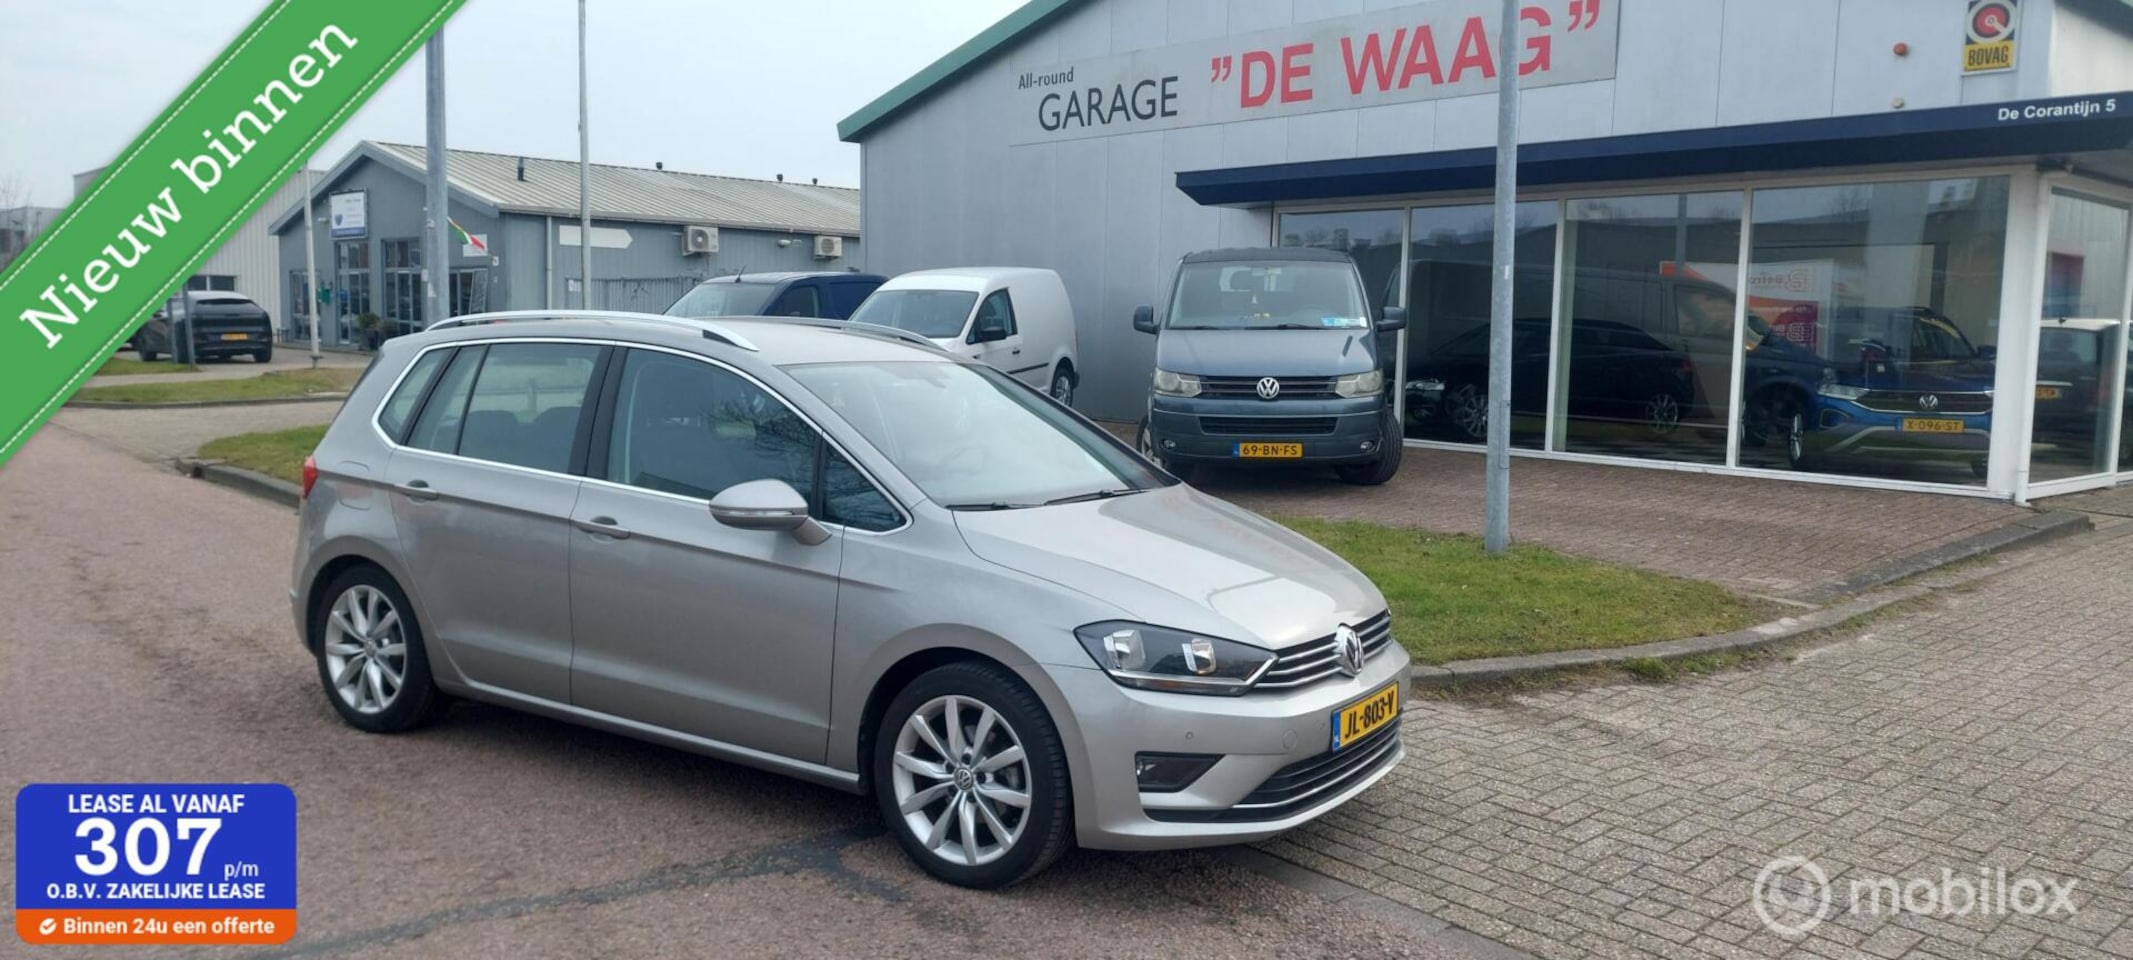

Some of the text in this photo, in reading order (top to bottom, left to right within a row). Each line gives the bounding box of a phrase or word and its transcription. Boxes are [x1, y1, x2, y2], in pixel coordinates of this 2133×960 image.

[1967, 46, 2010, 66] BOVAG
[1018, 66, 1074, 90] All-round
[1038, 76, 1178, 131] GARAGE
[1998, 99, 2116, 121] De Corantijn 5
[1242, 445, 1298, 456] 69-BN-FS
[1344, 690, 1395, 739] JL-803-V
